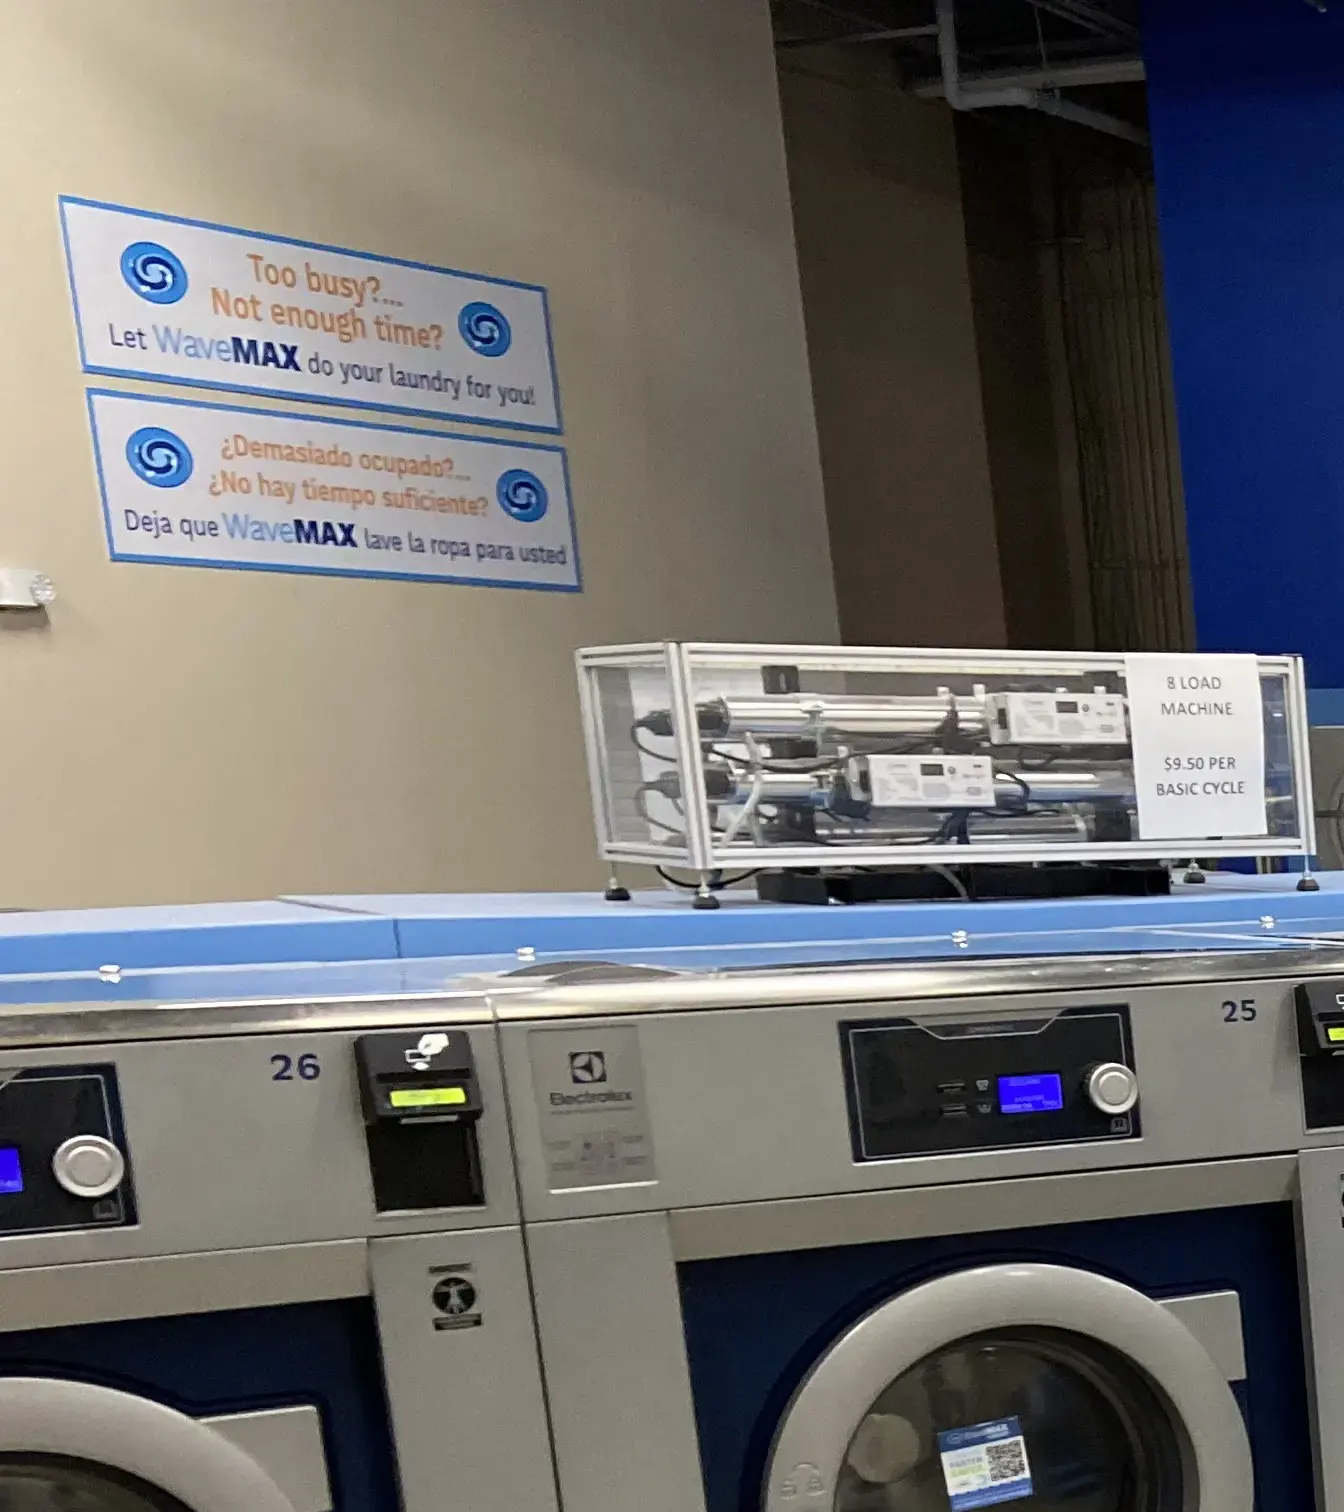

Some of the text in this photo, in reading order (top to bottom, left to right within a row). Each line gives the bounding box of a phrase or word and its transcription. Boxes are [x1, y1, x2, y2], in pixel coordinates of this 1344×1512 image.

[247, 253, 297, 288] Too
[210, 286, 444, 350] Not enough time?
[108, 323, 536, 408] Let WaveMAX do your laundry for you!
[221, 433, 352, 469] ¿Demasiado
[208, 469, 489, 518] ¿No hay tiempo suficiente?
[124, 508, 568, 567] Deja que WaveMAX lave la ropa para usted
[1166, 676, 1222, 690] 8 LOAD
[1161, 702, 1233, 716] MACHINE
[1163, 756, 1237, 772] $9.50 PER
[1155, 781, 1246, 796] BASIC CYCLE
[1221, 999, 1257, 1022] 25
[270, 1053, 321, 1081] 26
